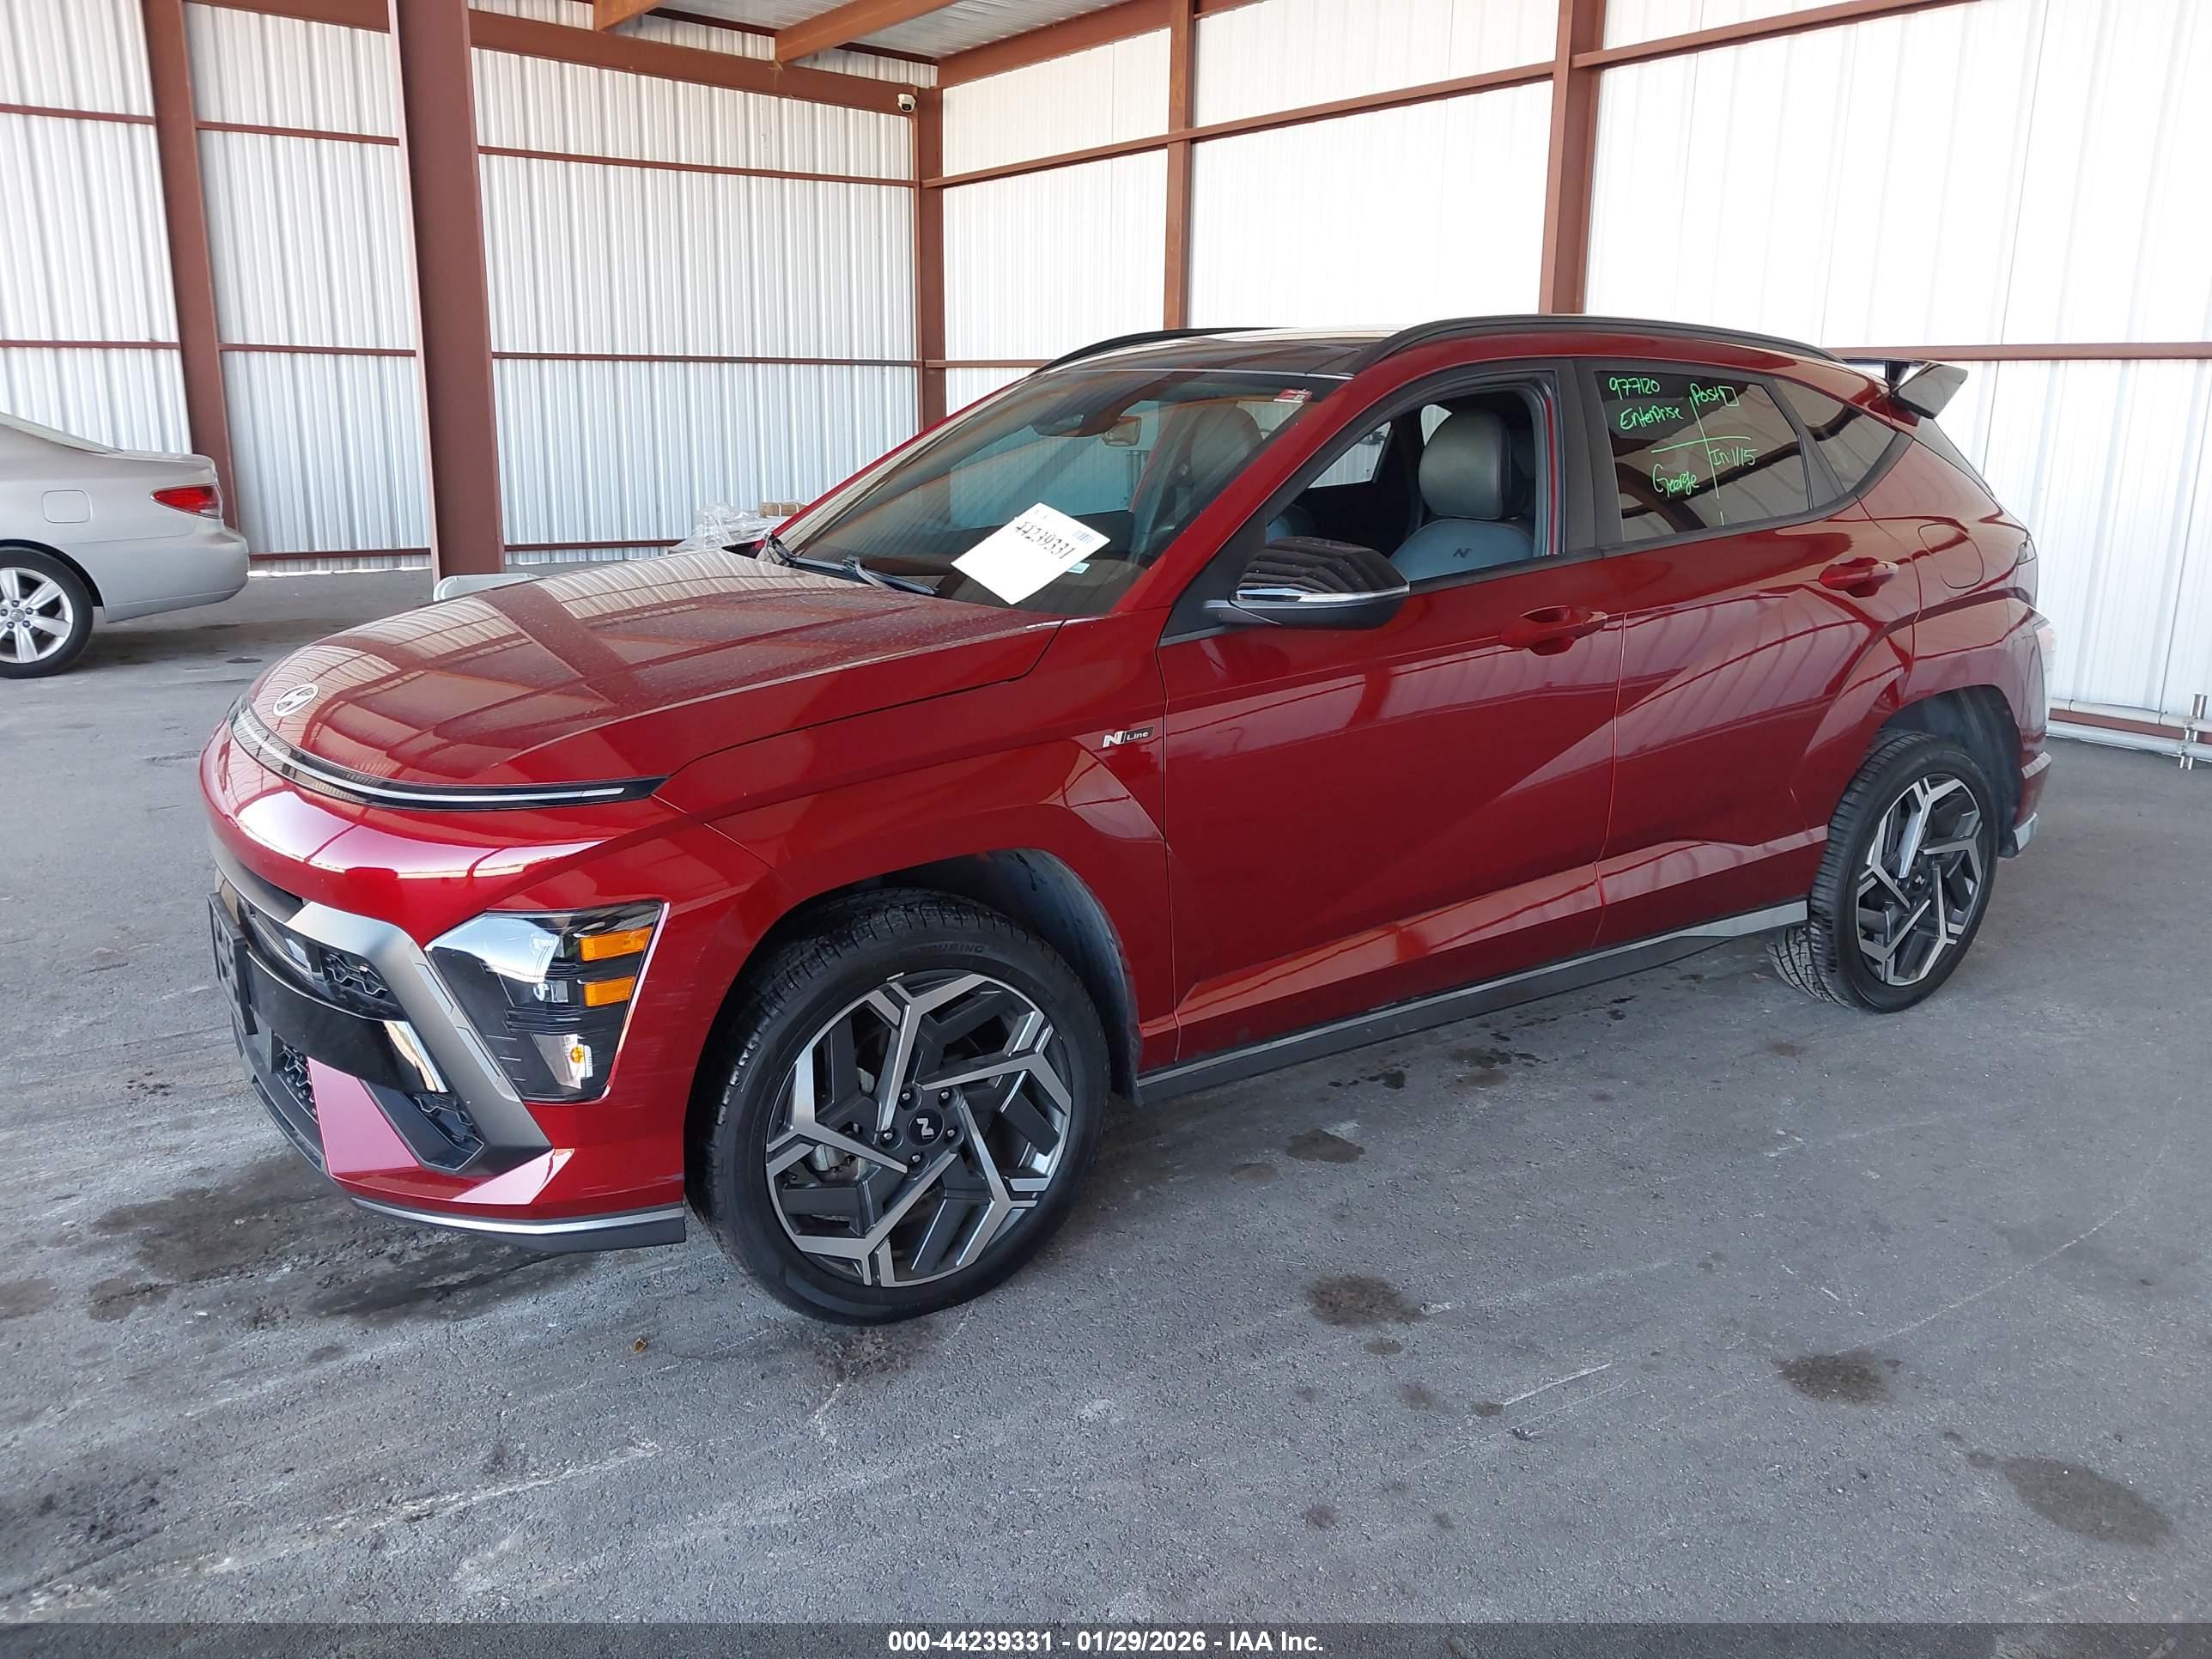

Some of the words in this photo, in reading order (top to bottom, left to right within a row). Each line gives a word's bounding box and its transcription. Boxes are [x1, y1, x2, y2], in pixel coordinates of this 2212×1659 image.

[1608, 376, 1662, 401] 977120
[1651, 463, 1700, 499] George
[1015, 520, 1076, 559] 44239331
